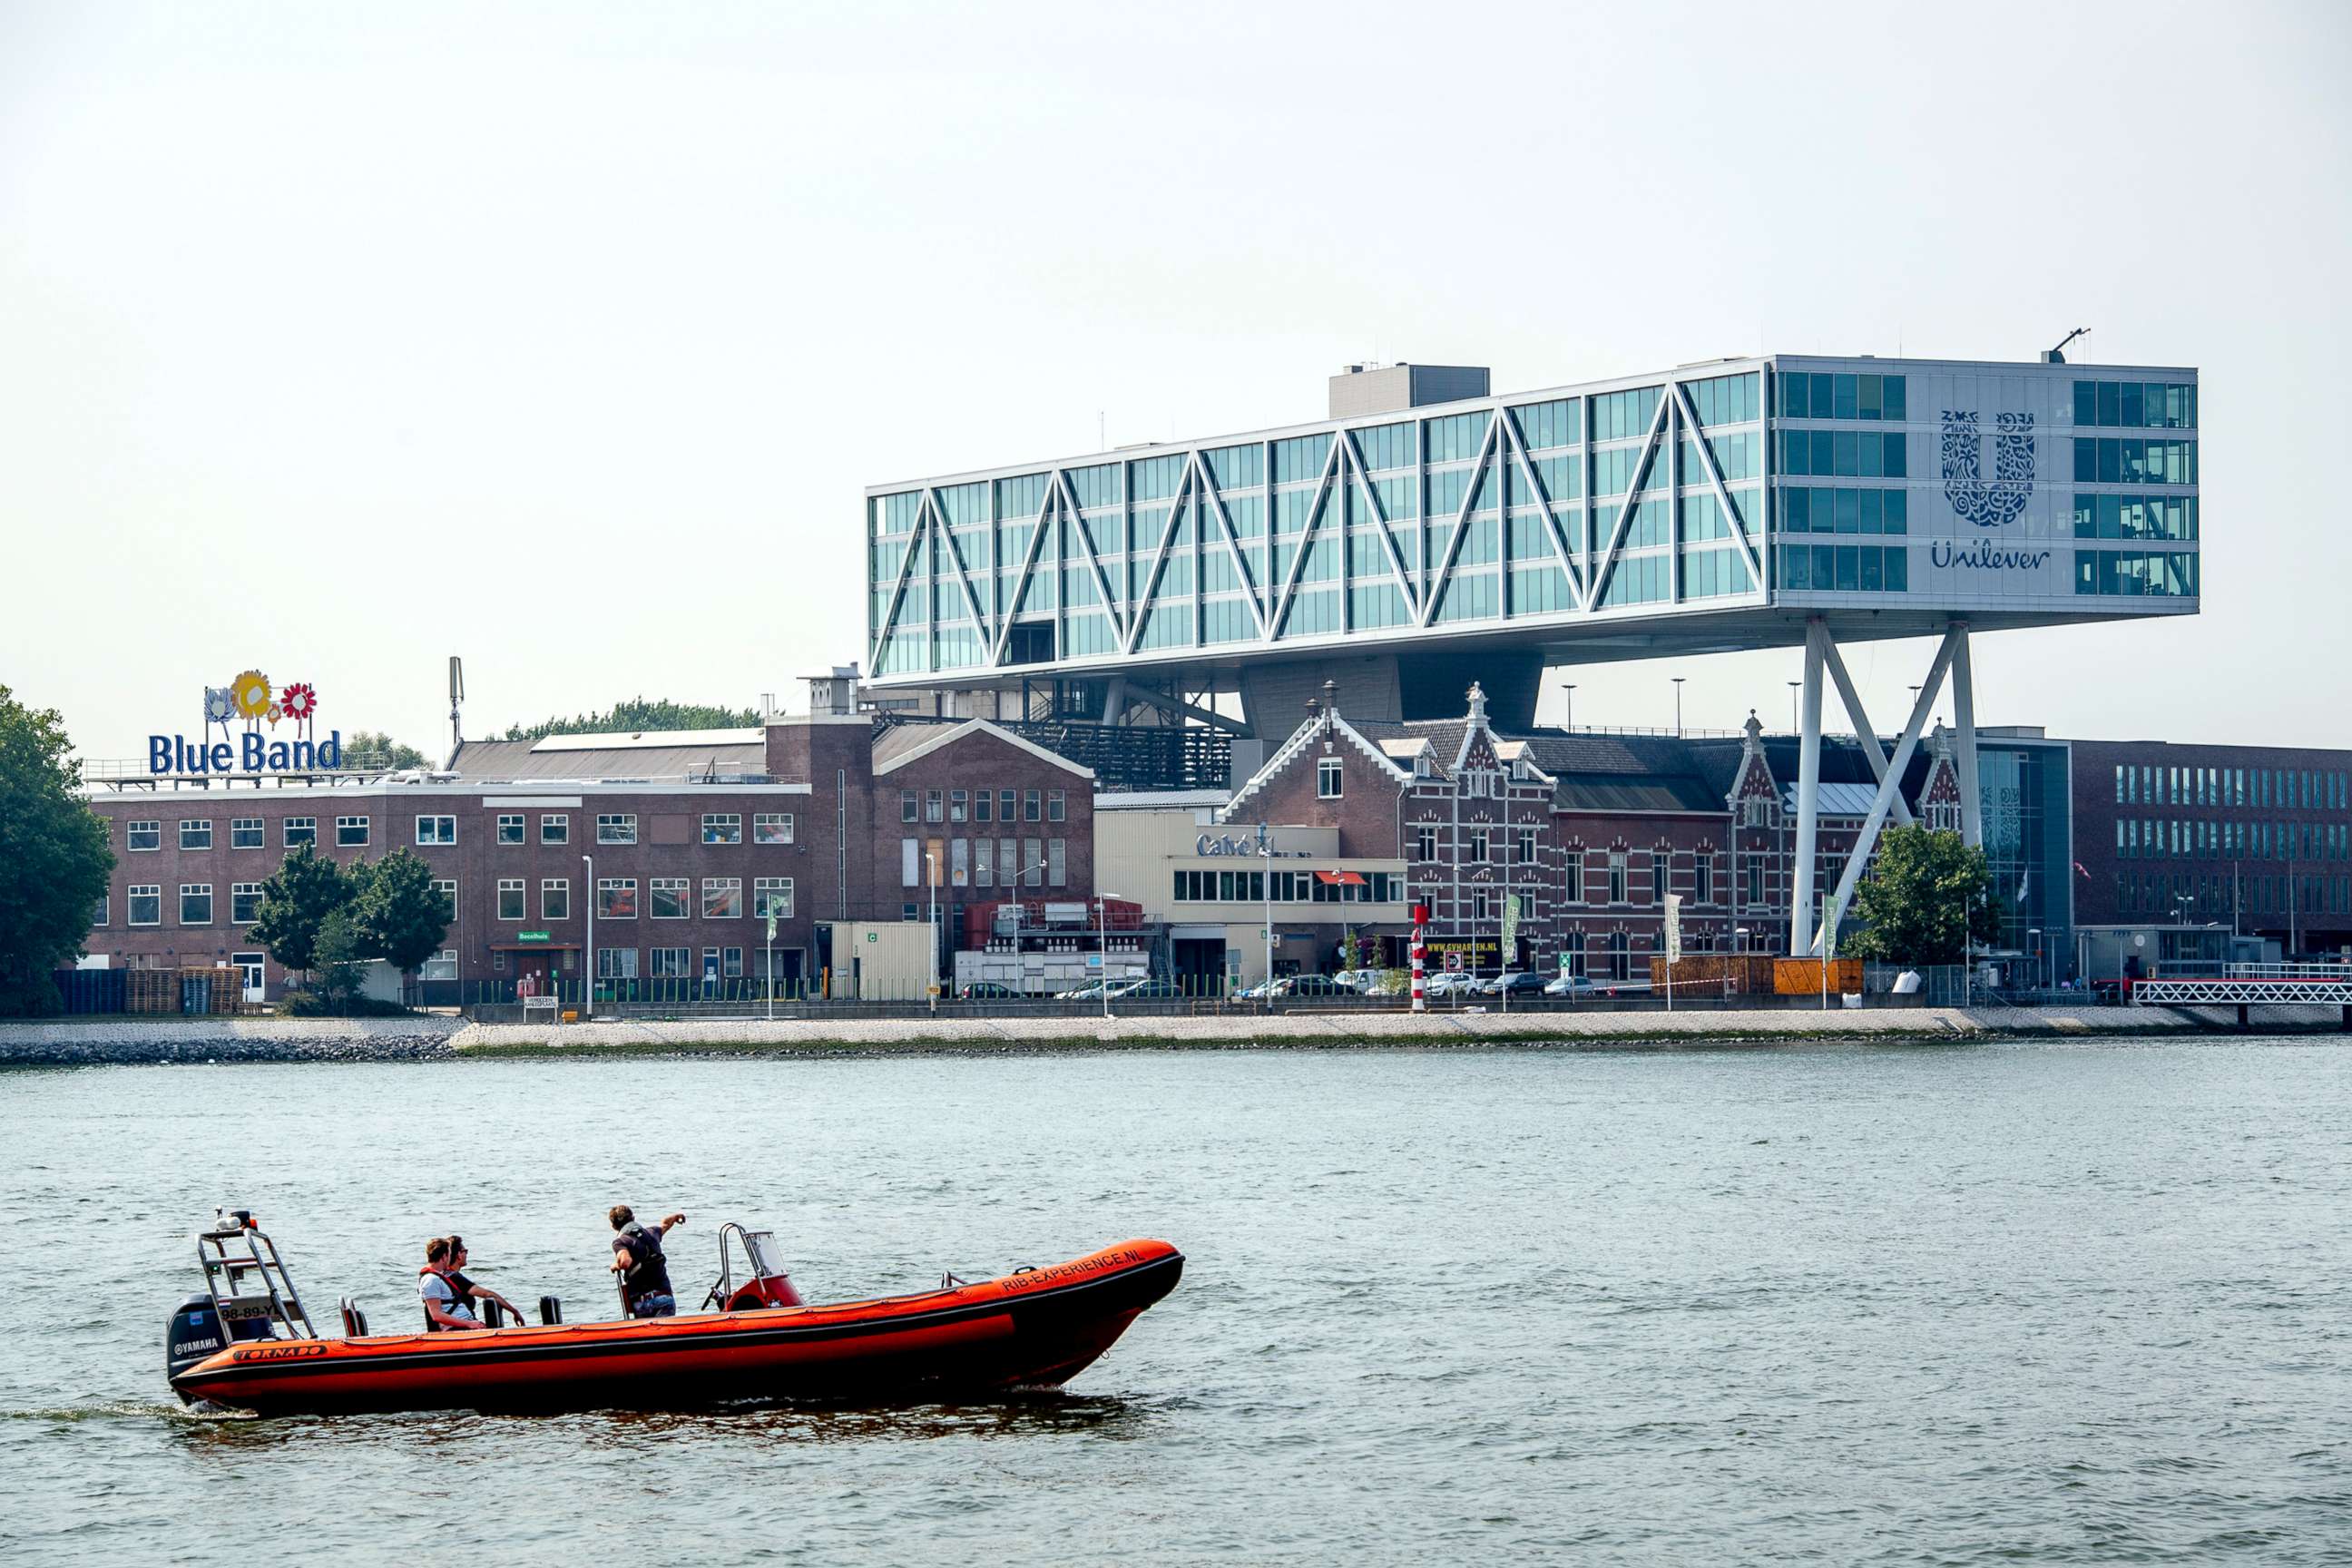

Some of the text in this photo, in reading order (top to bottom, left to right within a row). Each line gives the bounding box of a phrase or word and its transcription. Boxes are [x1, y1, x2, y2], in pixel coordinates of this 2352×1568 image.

[1931, 538, 2050, 570] Unilever
[149, 730, 341, 773] Blue Band
[1197, 834, 1250, 857] Calvé
[1002, 1249, 1146, 1292] RIB-EXPERIENCE.NL
[182, 1337, 219, 1353] YAMAHA
[239, 1345, 322, 1360] TORNADO
